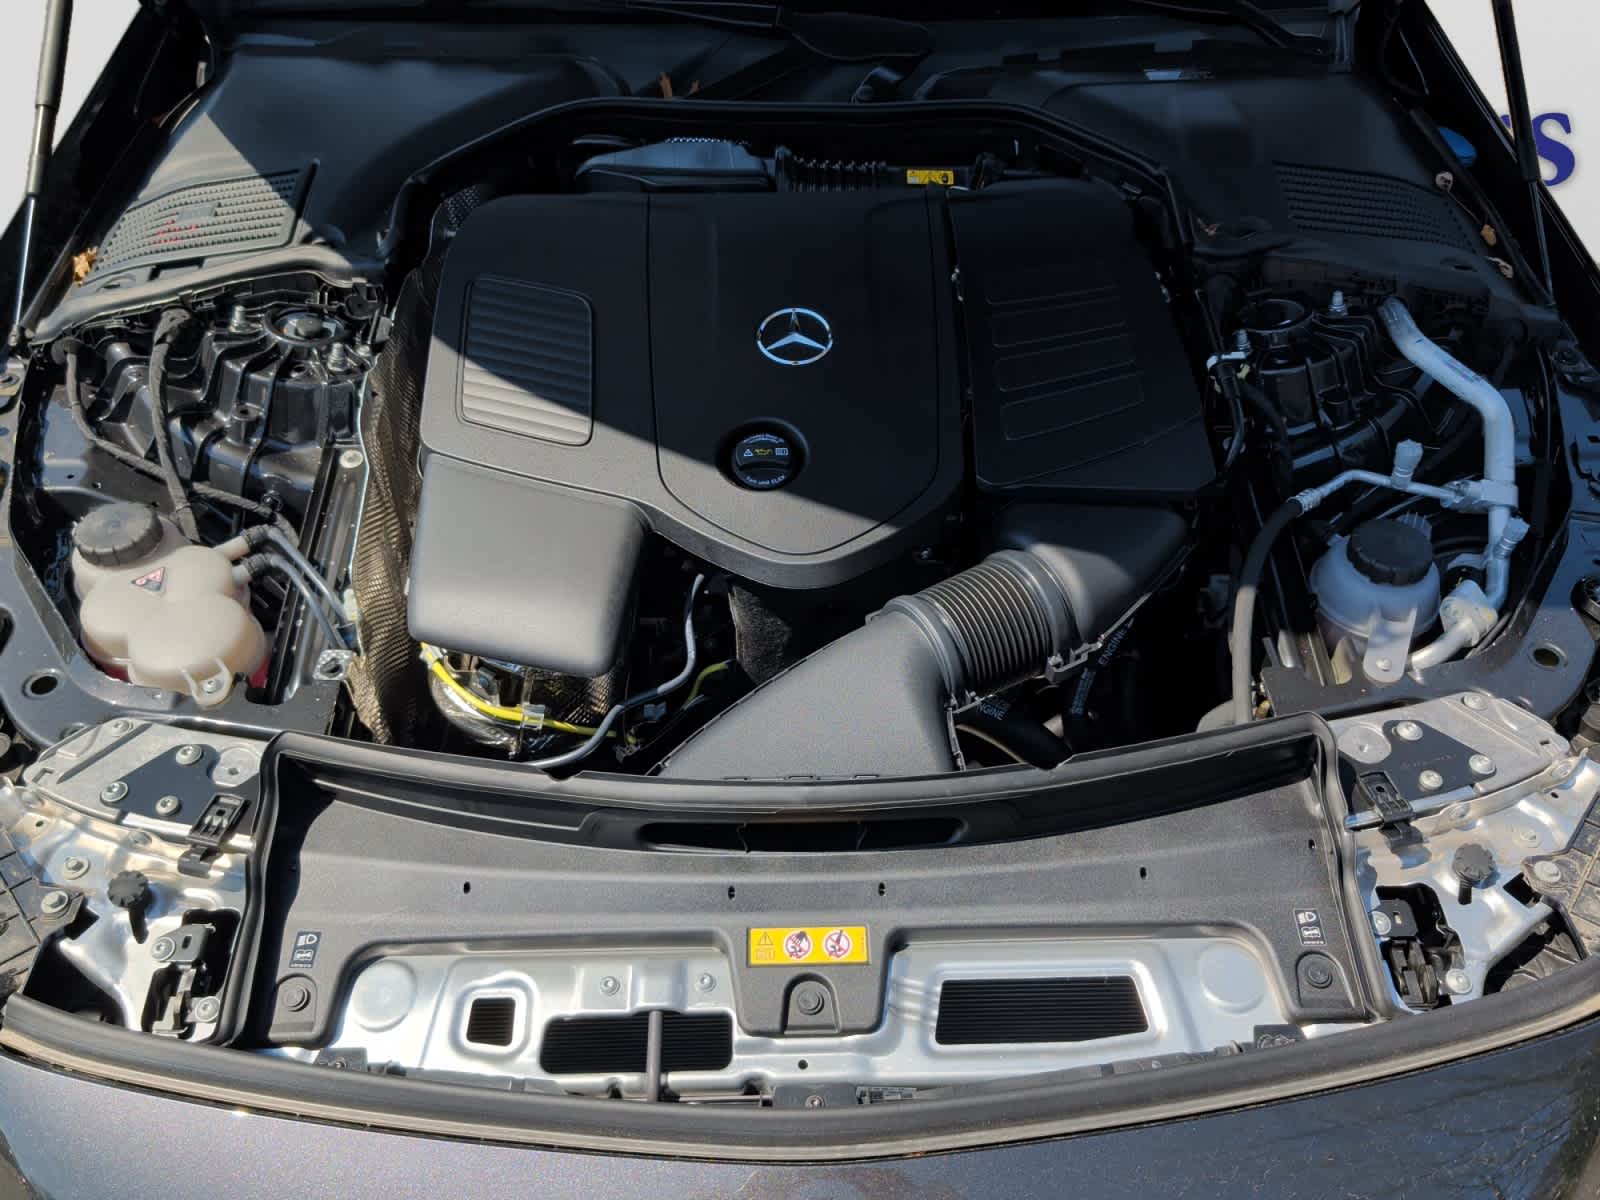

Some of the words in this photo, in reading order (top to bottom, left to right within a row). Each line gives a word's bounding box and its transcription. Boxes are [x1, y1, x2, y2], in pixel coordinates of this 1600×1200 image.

[1501, 112, 1575, 187] S
[1097, 627, 1127, 666] ENGINE
[976, 702, 1006, 721] NGINE
